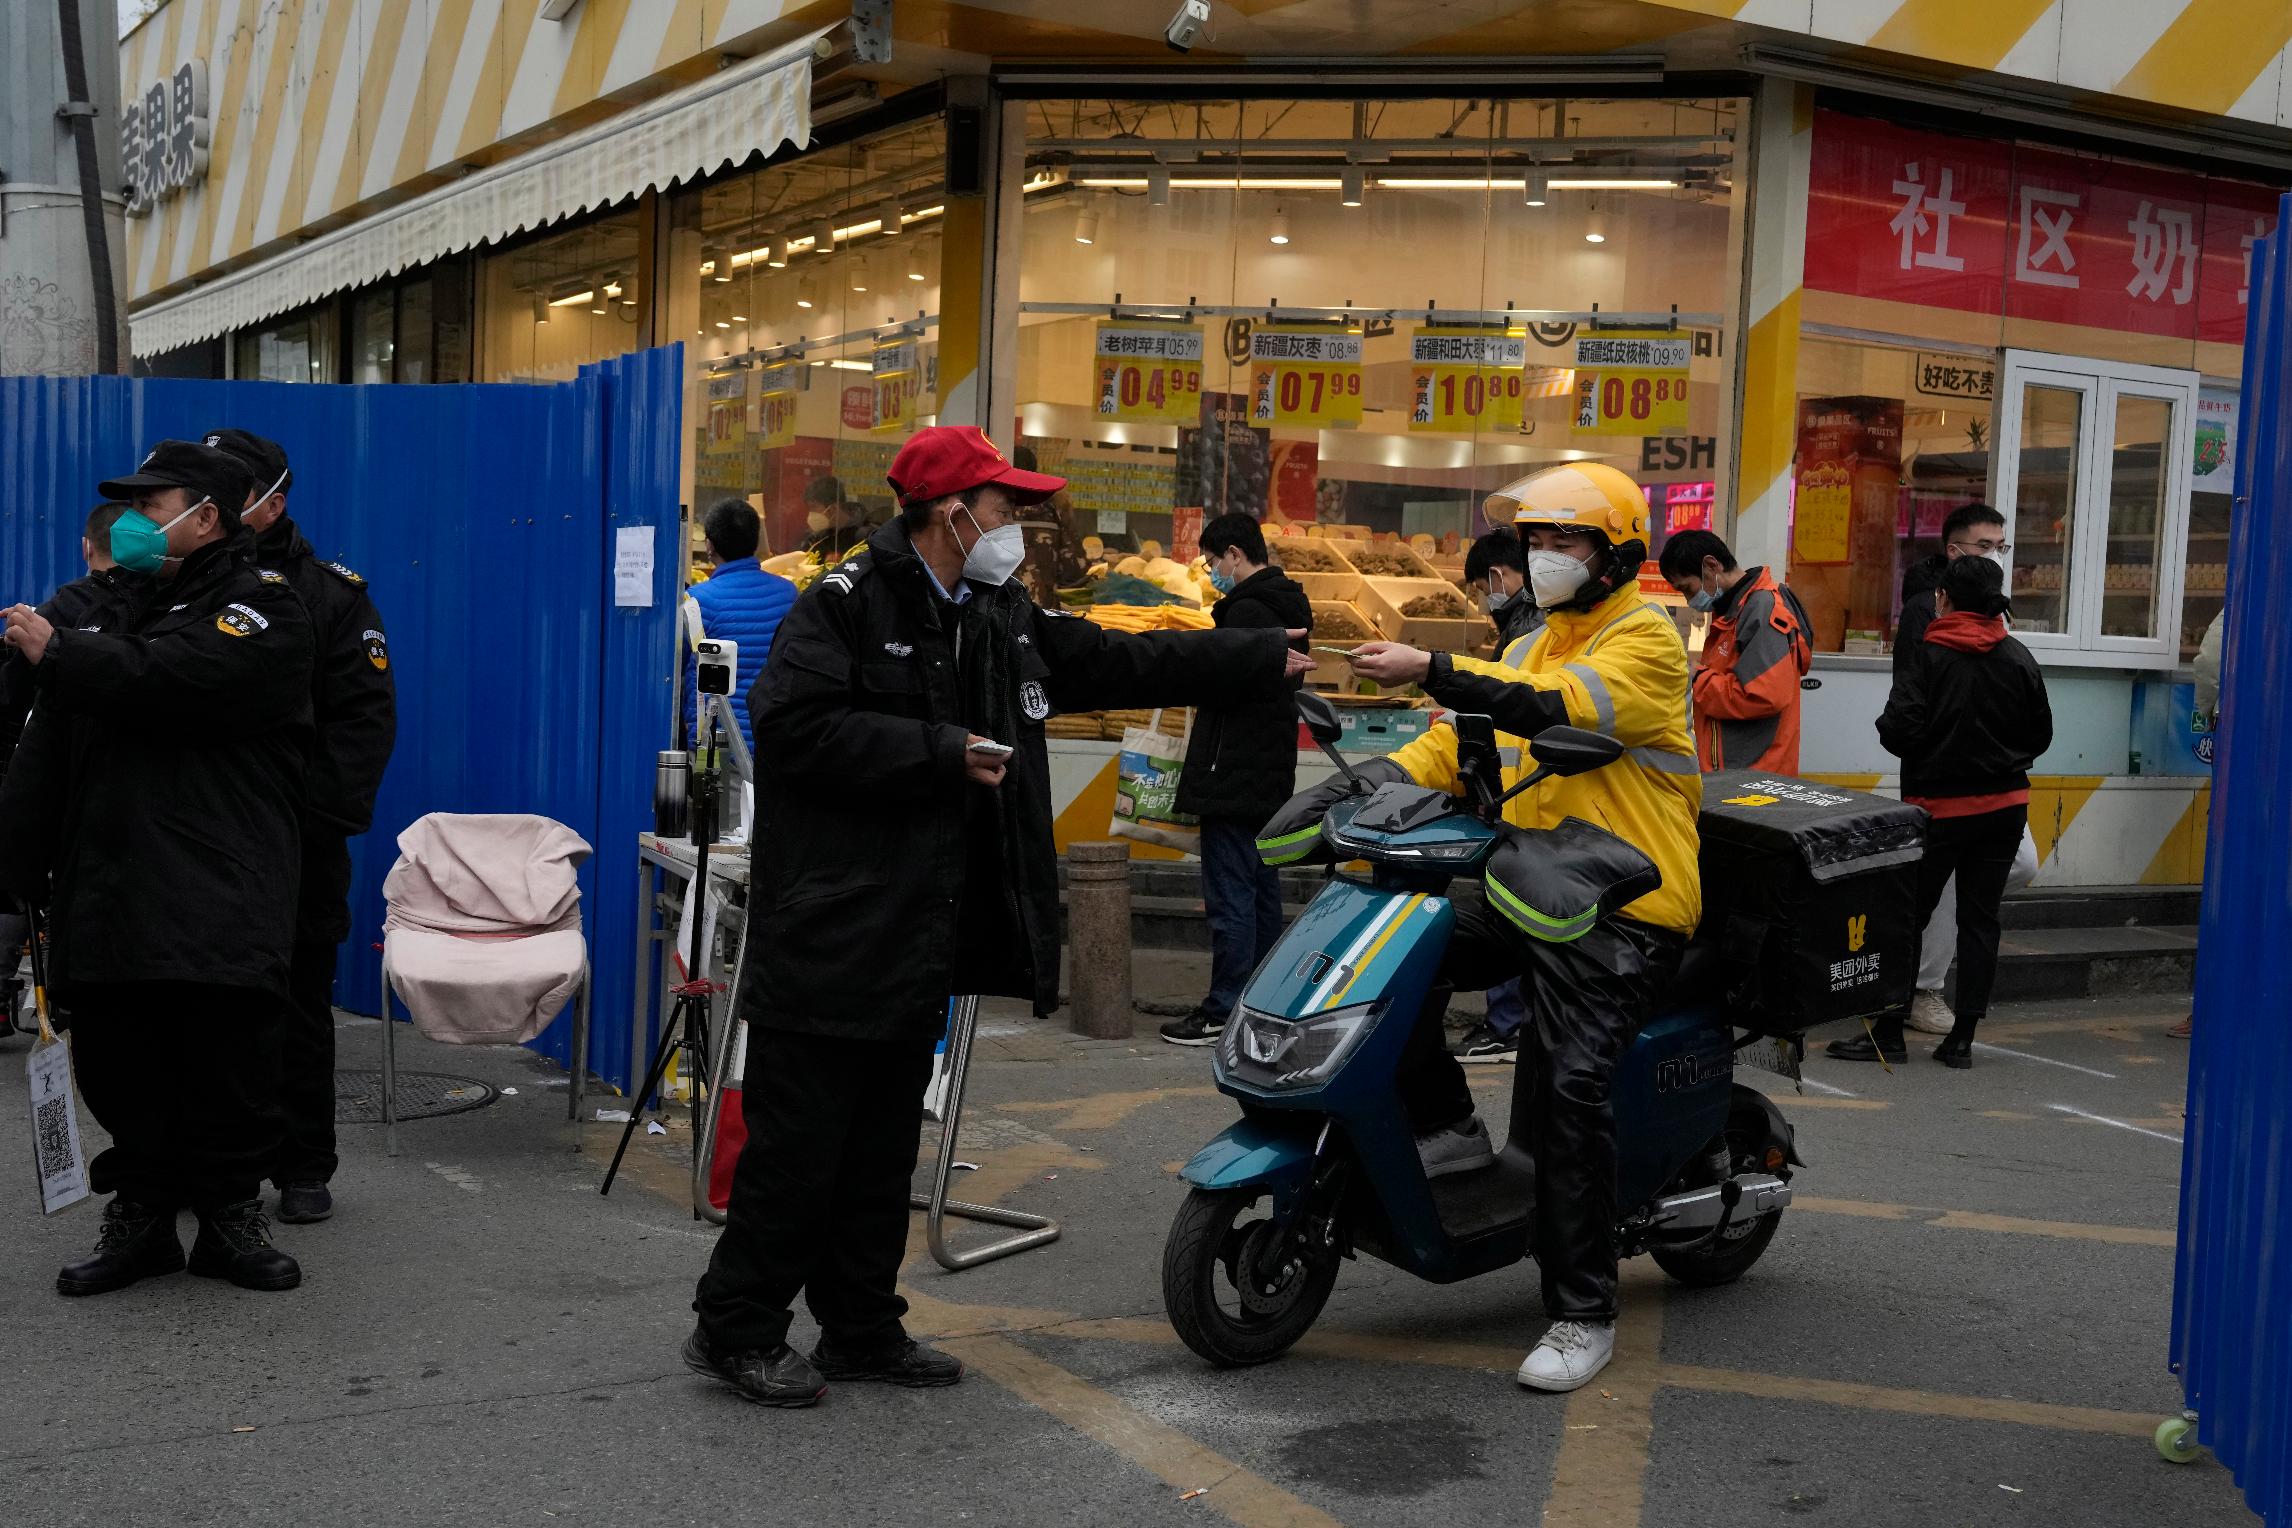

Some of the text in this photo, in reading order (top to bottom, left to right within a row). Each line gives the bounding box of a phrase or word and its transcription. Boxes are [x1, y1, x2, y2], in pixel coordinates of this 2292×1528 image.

[1254, 334, 1321, 359] 新疆灰枣
[1415, 337, 1485, 360] 新疆和田大枣
[1577, 340, 1685, 366] 新疆纸皮核桃 09.90
[1100, 367, 1115, 414] 会员价
[1121, 366, 1200, 410] 04.99
[1256, 371, 1271, 419] 会员价
[1280, 371, 1361, 413] 07.99
[1414, 375, 1429, 423] 会员价
[1440, 374, 1521, 416] 10.80
[1603, 377, 1687, 420] 08.80
[1924, 363, 1994, 395] 好吃不贵
[1577, 378, 1593, 427] 会员价
[1829, 952, 1881, 982] 美团外卖
